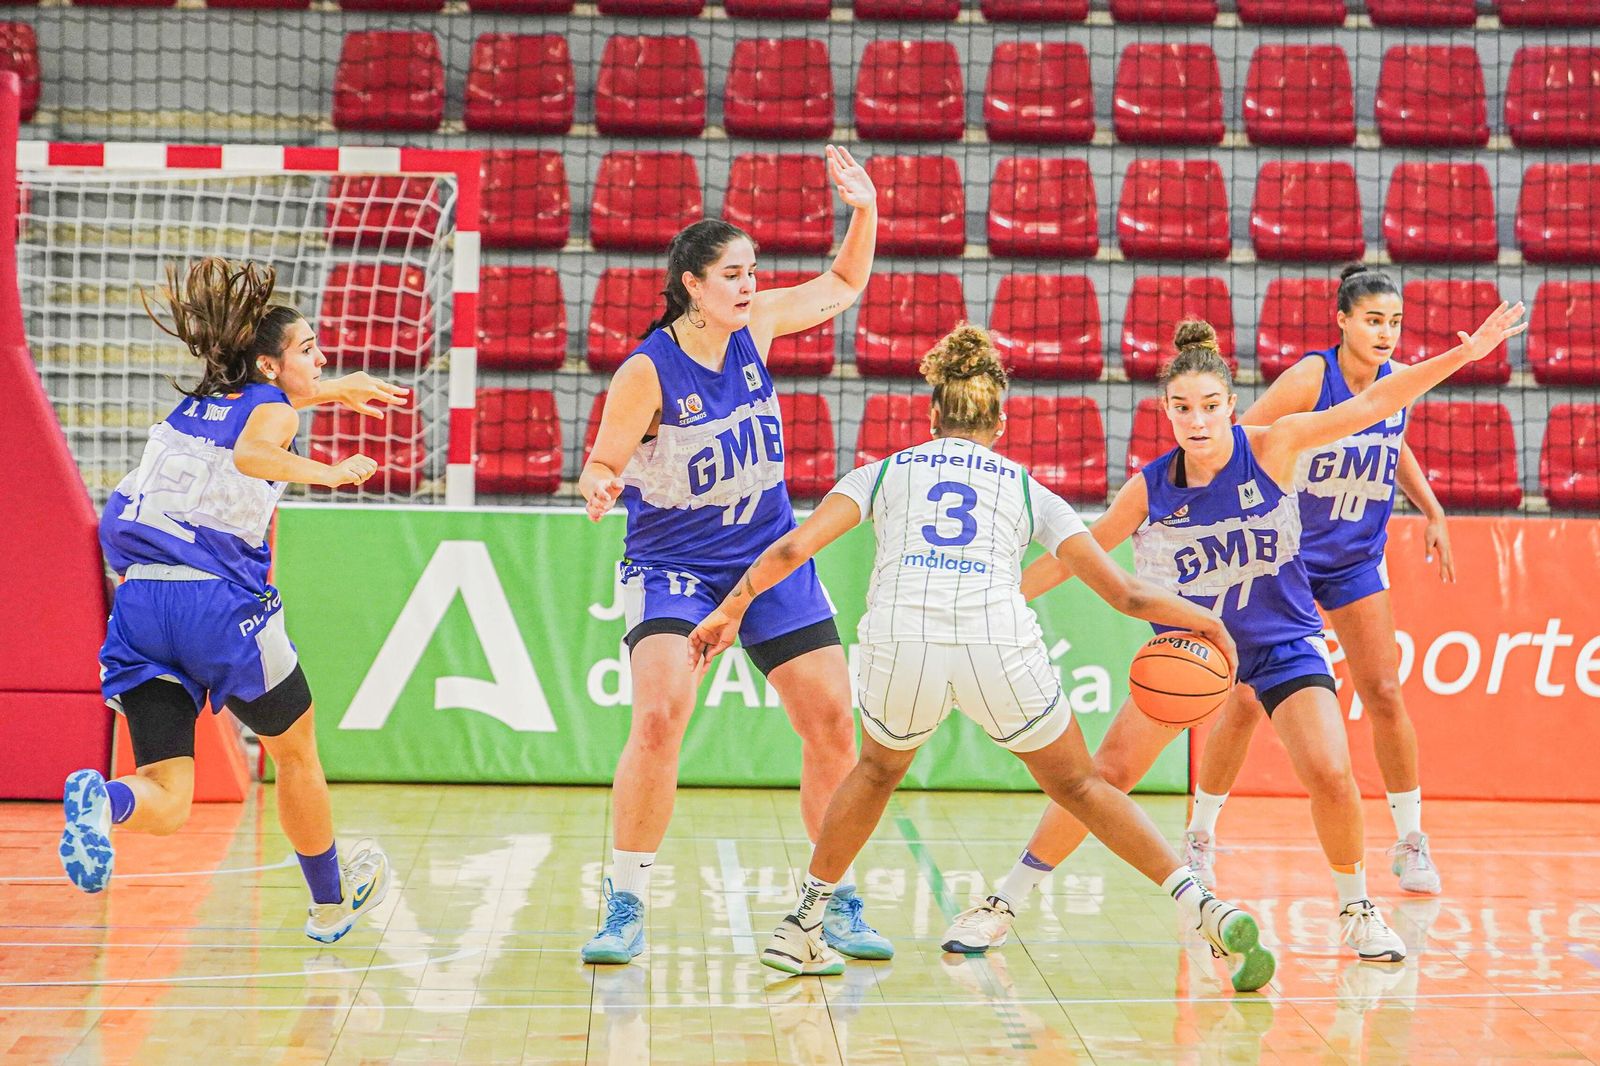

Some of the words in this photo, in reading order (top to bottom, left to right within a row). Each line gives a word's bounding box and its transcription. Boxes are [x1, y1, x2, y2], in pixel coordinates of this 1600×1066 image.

[687, 415, 783, 497] GMB
[896, 451, 1016, 479] Capellán
[1307, 444, 1399, 486] GMB
[118, 438, 212, 544] 12
[721, 481, 763, 526] 17
[1329, 490, 1368, 523] 10
[921, 480, 978, 547] 3
[904, 550, 987, 574] málaga
[1174, 527, 1278, 585] GMB
[661, 569, 702, 598] 17
[1147, 637, 1210, 662] Wilson
[796, 887, 820, 920] UNICAJA
